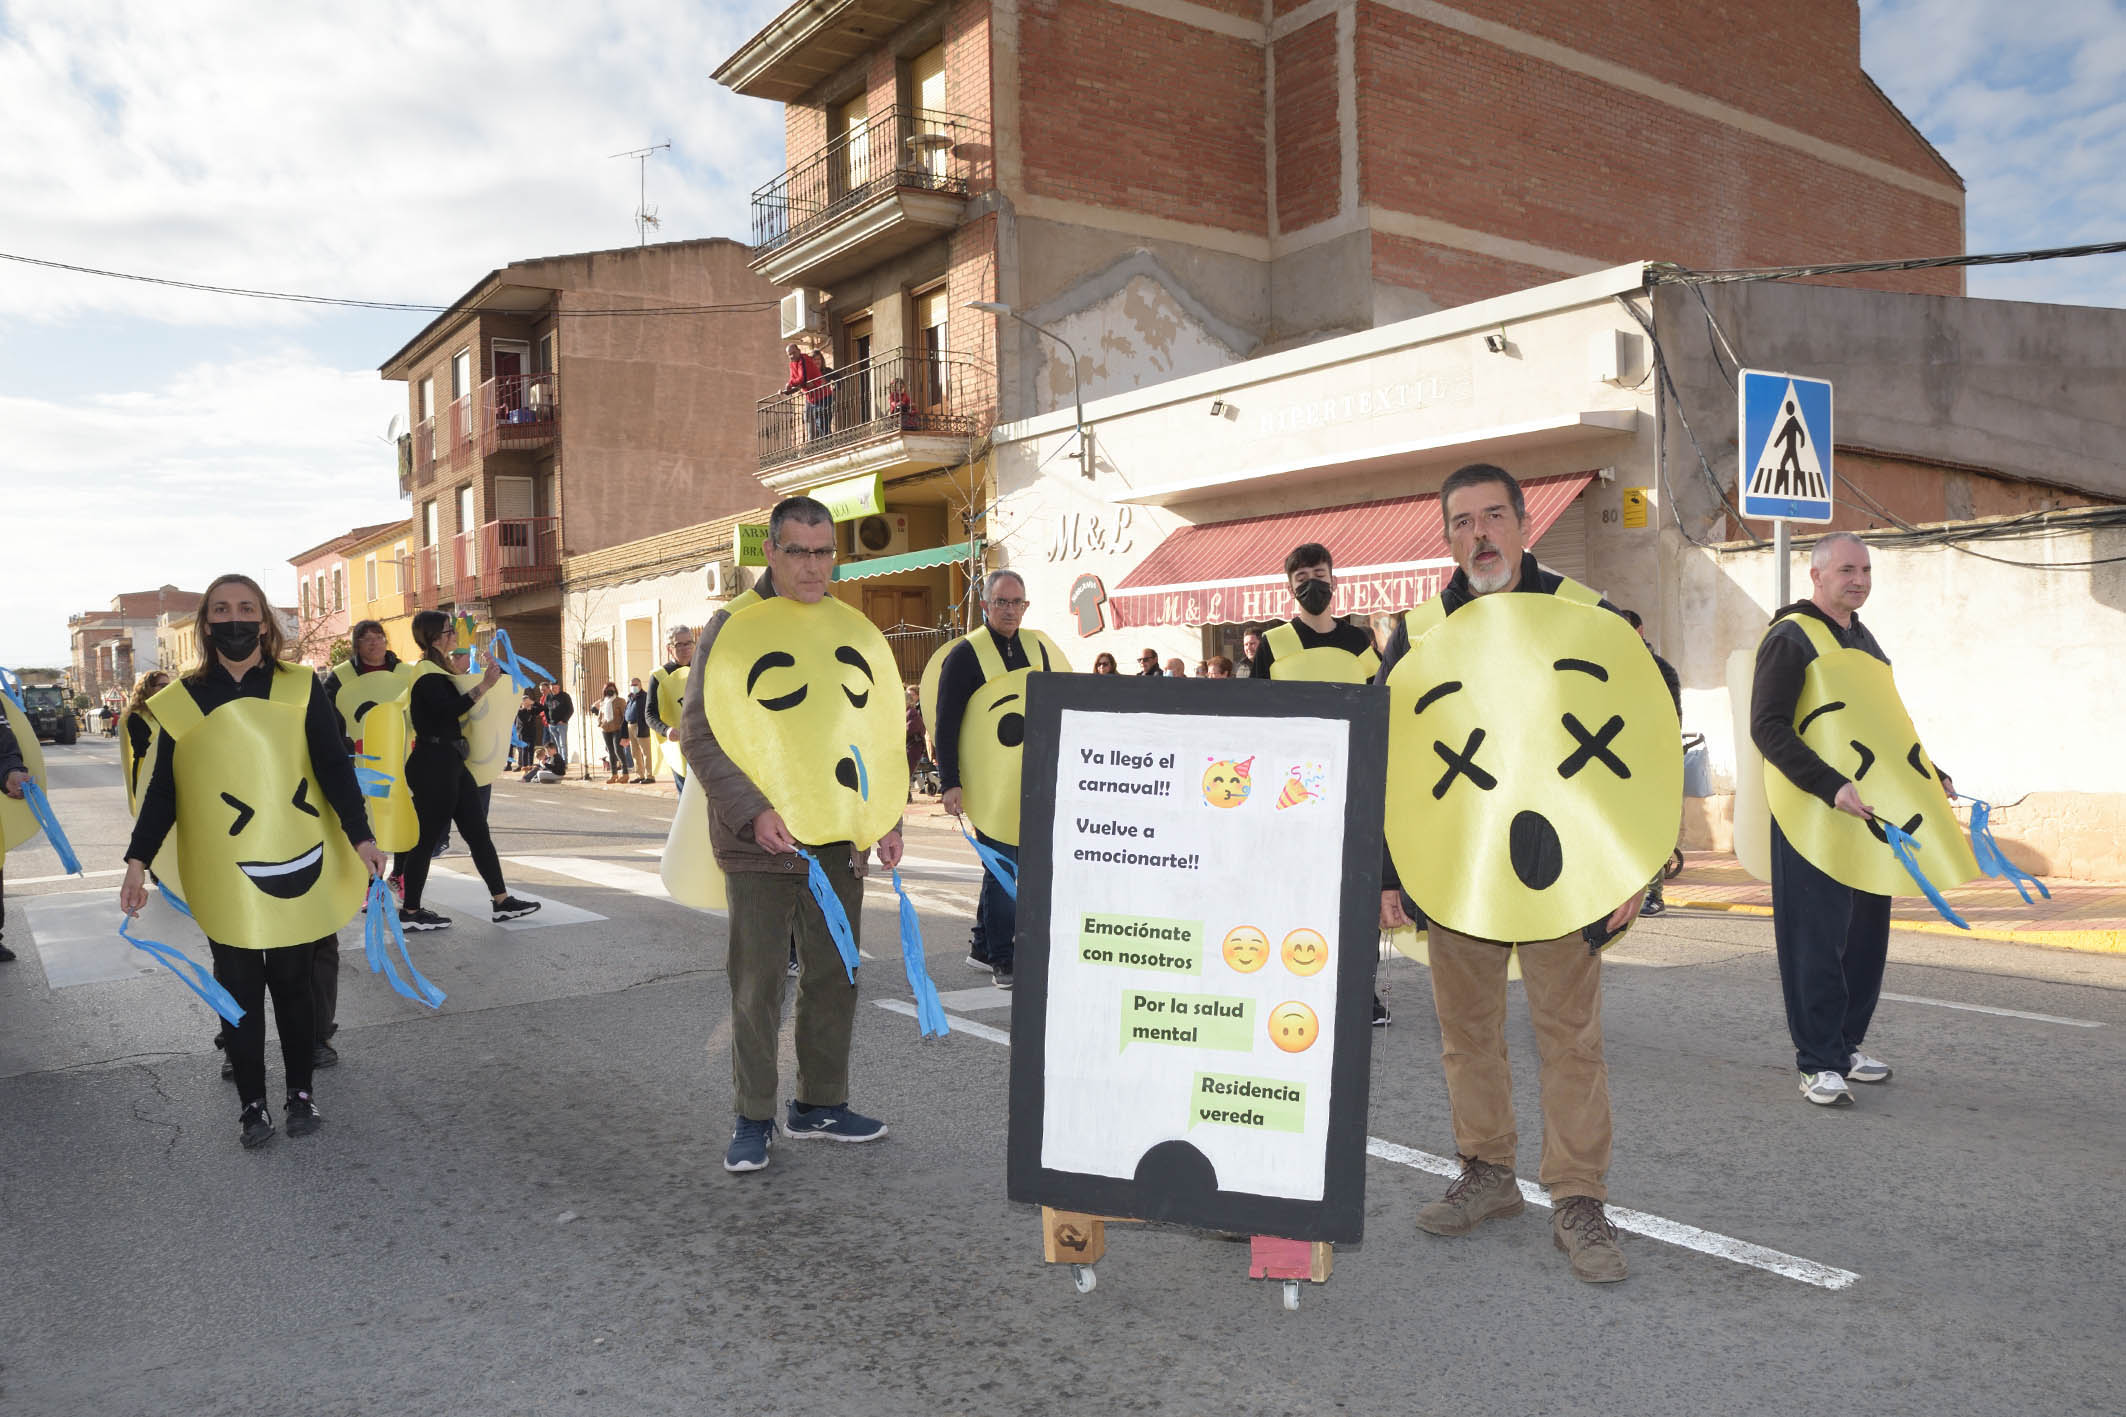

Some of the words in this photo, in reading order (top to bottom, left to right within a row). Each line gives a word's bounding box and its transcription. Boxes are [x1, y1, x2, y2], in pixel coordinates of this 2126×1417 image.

[1602, 509, 1618, 524] 80
[742, 527, 769, 538] ARM
[743, 546, 765, 557] BRA
[1156, 595, 1180, 623] M
[1186, 598, 1200, 621] &
[1242, 575, 1441, 618] HIPTEXTI
[1080, 748, 1104, 765] Ya
[1110, 750, 1154, 770] llegó
[1159, 753, 1175, 769] el
[1078, 779, 1171, 797] carnaval!!
[1076, 817, 1138, 838] Vuelve
[1143, 827, 1155, 839] a
[1073, 848, 1200, 870] emocionarte!!
[1084, 917, 1192, 942] Emociónate
[1082, 948, 1113, 962] con
[1118, 951, 1192, 970] nosotros
[1134, 995, 1165, 1013] Por
[1170, 997, 1188, 1014] la
[1193, 1001, 1244, 1018] salud
[1132, 1026, 1198, 1043] mental
[1201, 1077, 1300, 1102] Residencia
[1199, 1109, 1265, 1126] vereda
